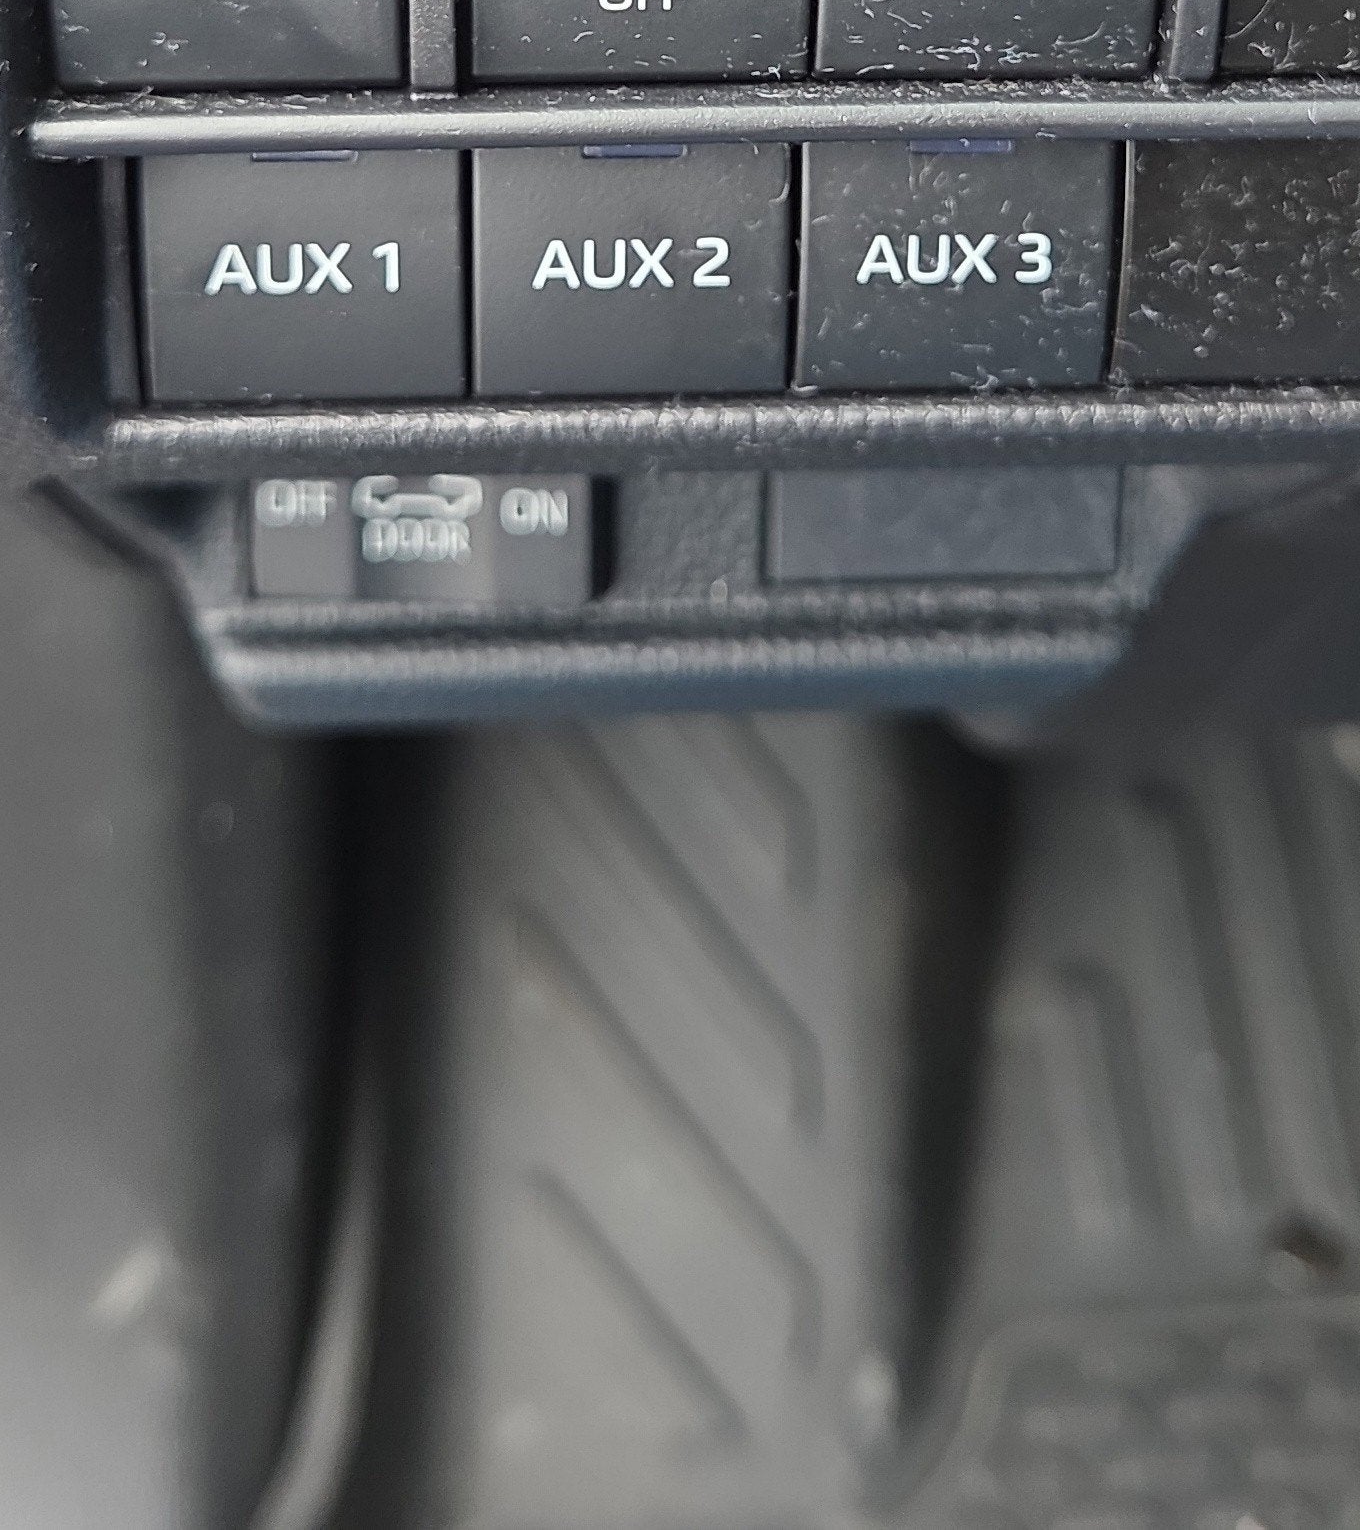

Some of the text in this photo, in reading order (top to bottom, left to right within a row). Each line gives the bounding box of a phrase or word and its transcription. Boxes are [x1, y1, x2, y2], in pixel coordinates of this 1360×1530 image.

[204, 241, 401, 296] AUX 1
[531, 235, 732, 290] AUX 2
[855, 231, 1053, 288] AUX 3
[499, 486, 570, 537] ON
